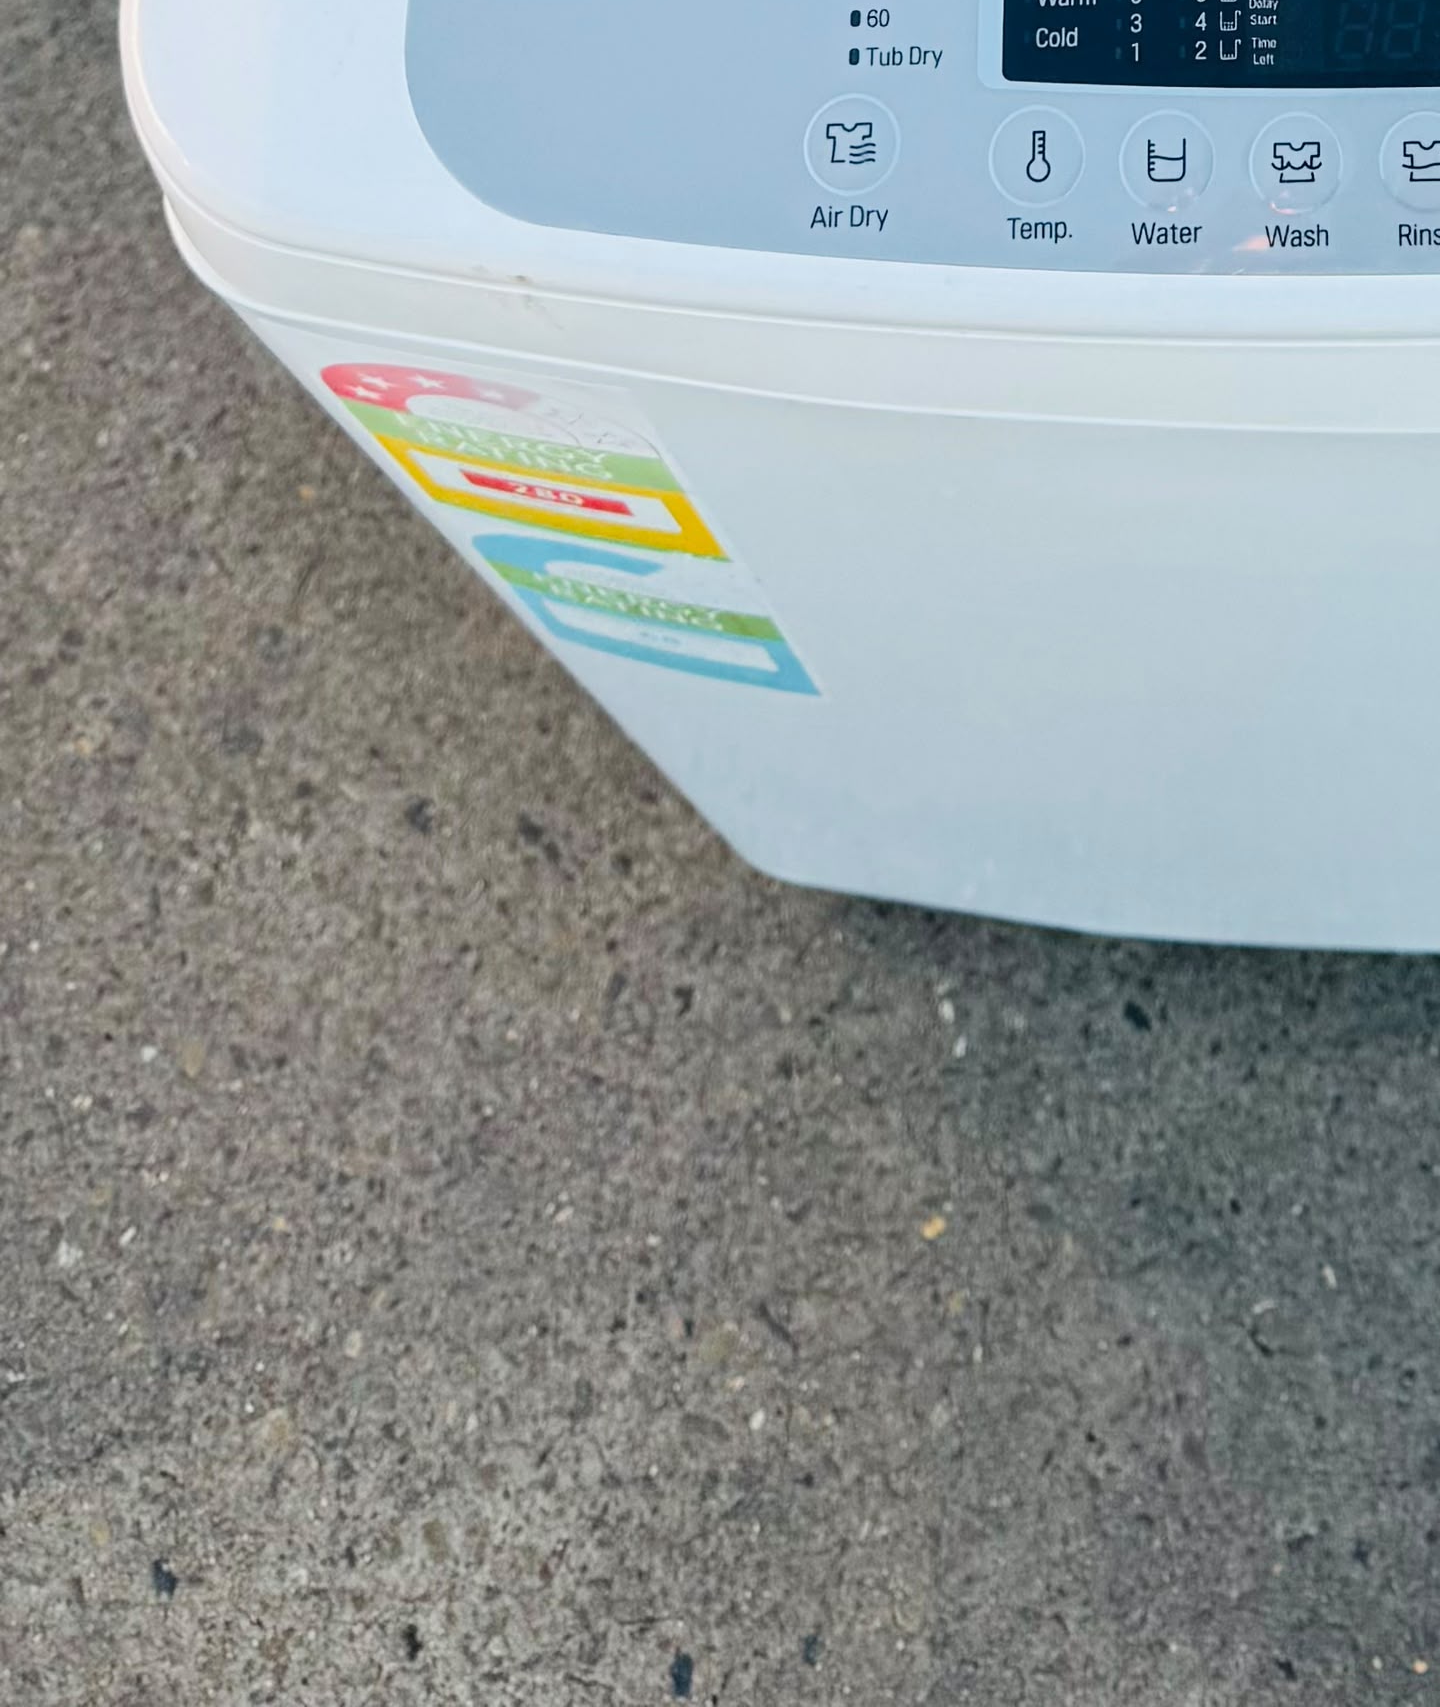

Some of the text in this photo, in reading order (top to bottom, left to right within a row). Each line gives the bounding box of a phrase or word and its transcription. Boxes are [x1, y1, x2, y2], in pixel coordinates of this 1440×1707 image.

[866, 8, 890, 28] 60
[1130, 13, 1143, 34] 3
[1194, 11, 1207, 32] 4
[1249, 13, 1277, 26] Start
[1035, 26, 1079, 48] Cold
[1251, 37, 1277, 49] Time
[865, 45, 943, 69] Tub Dry
[1131, 42, 1139, 62] 1
[1195, 40, 1207, 60] 2
[1253, 53, 1275, 66] Left
[810, 204, 889, 232] Air Dry
[1006, 217, 1073, 244] Temp.
[1131, 222, 1203, 245] Water
[1264, 223, 1329, 248] Wash
